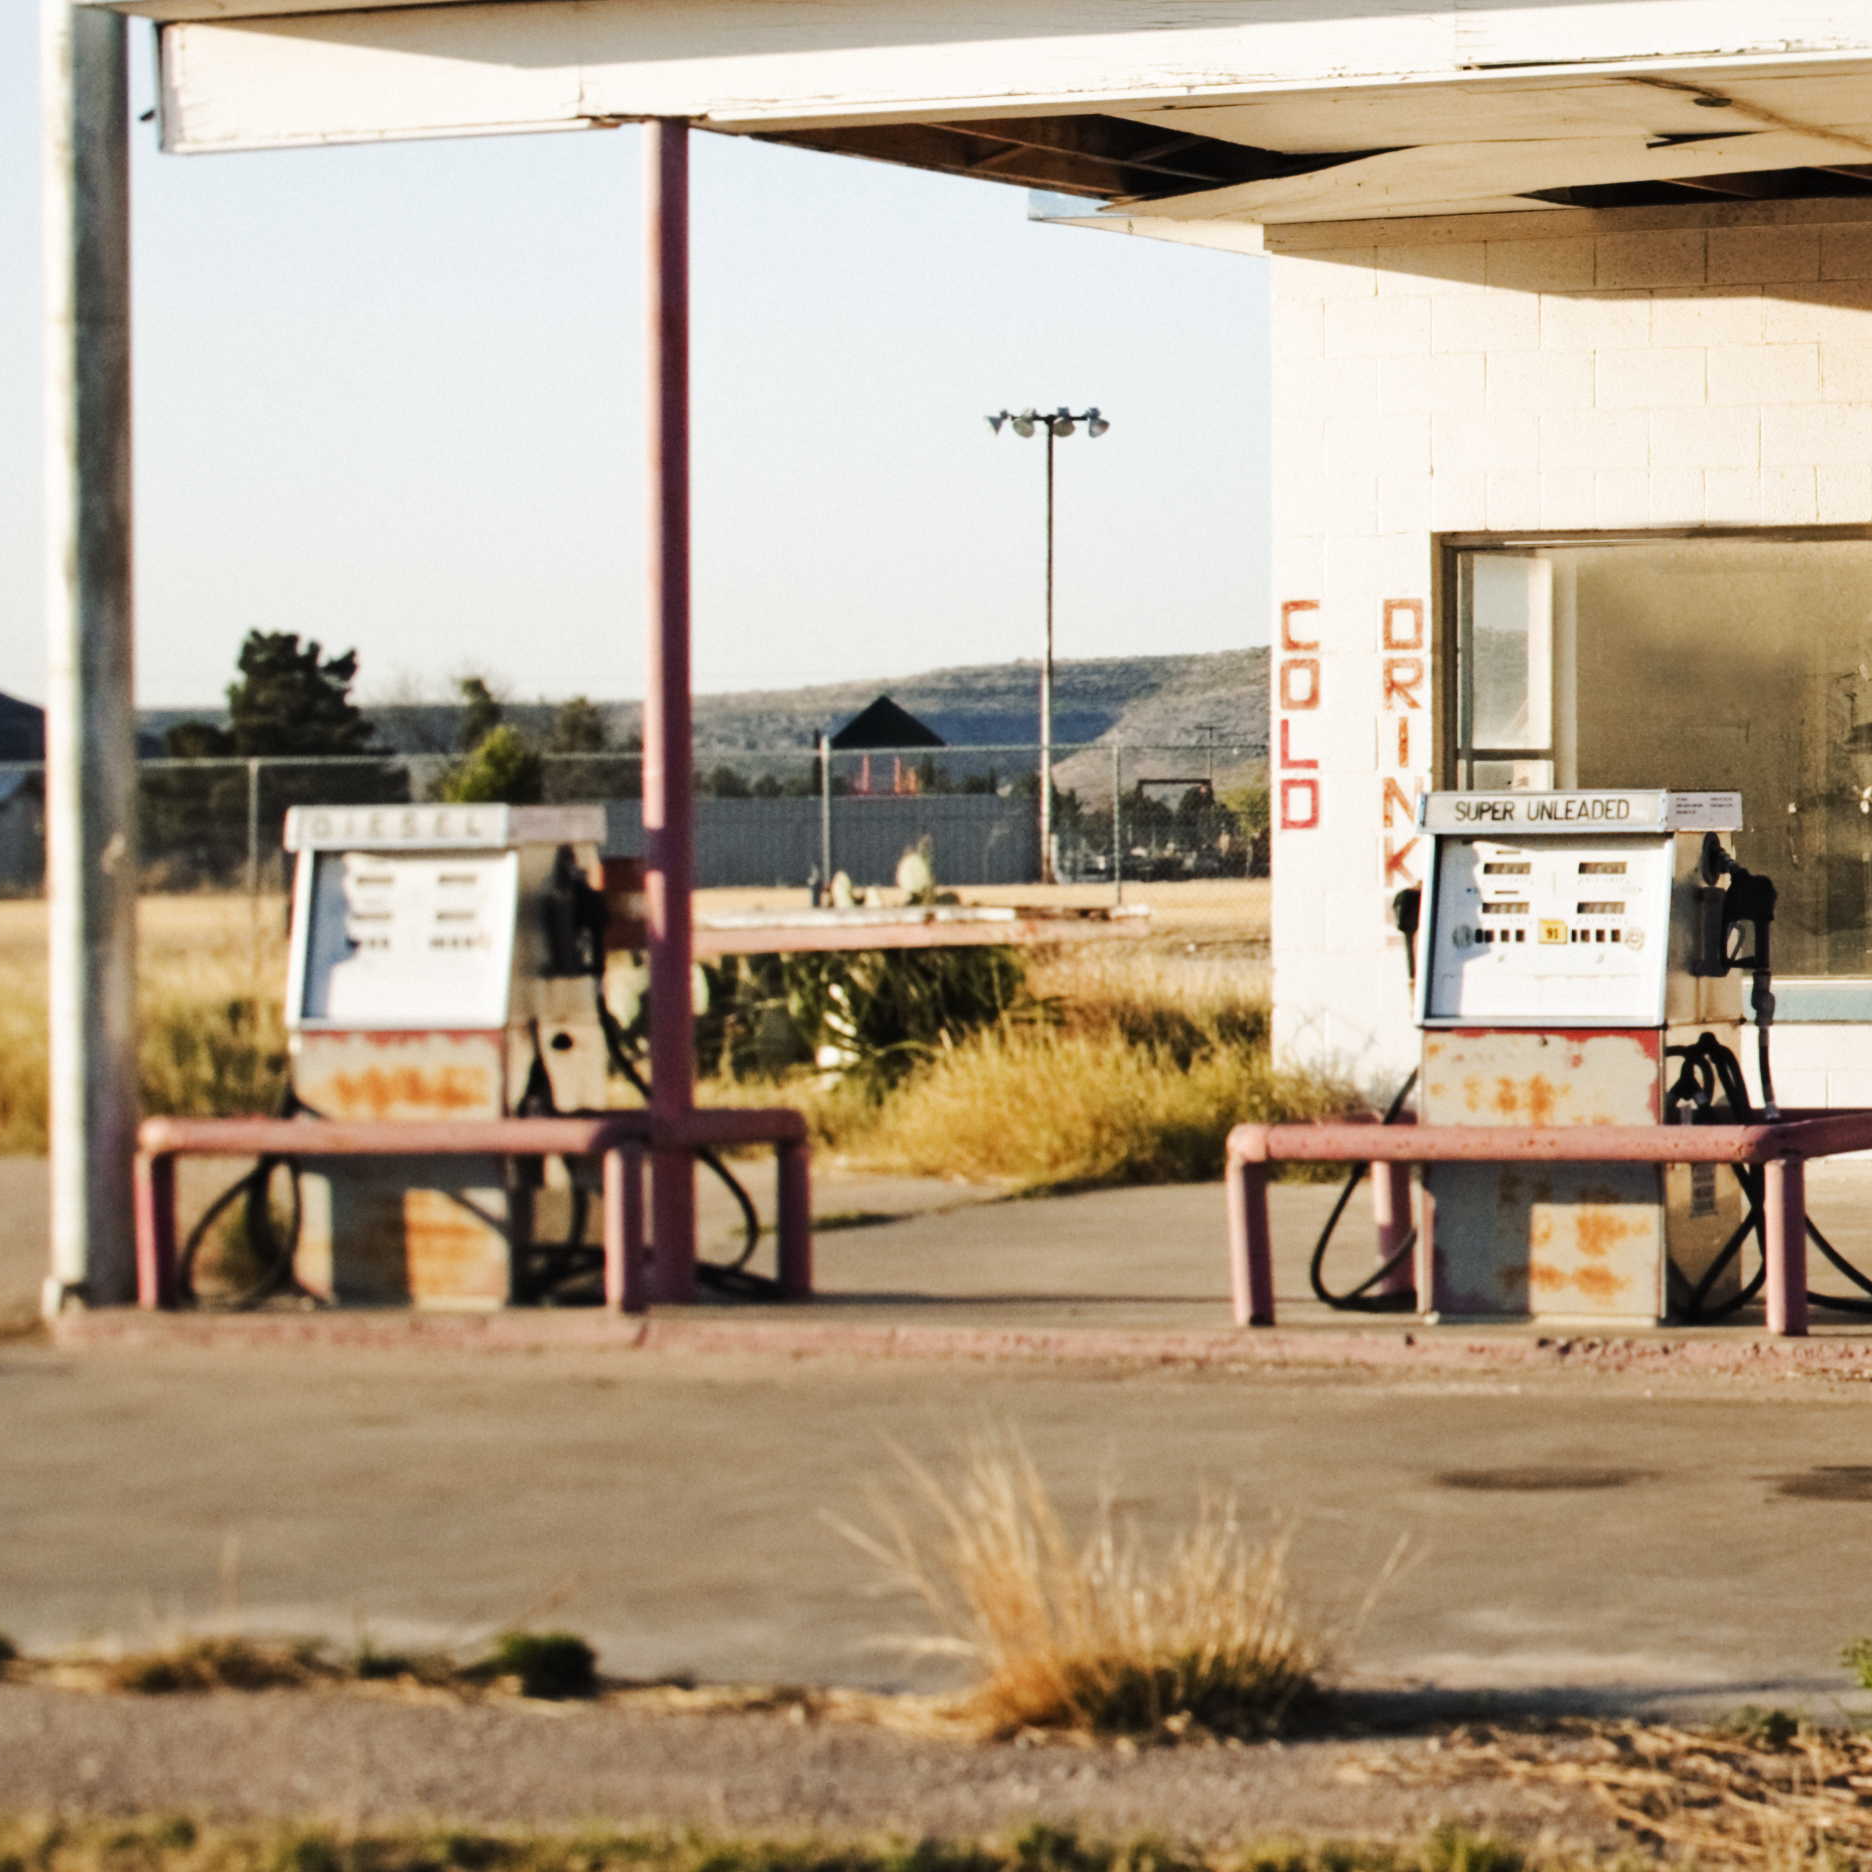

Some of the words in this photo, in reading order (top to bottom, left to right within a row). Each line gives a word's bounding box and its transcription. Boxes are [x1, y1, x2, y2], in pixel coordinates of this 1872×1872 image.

[1280, 598, 1321, 830] COLD
[1455, 799, 1515, 822] SUPER
[1527, 798, 1630, 822] UNLEADED
[311, 810, 483, 839] DIESEL
[1545, 926, 1560, 940] 91
